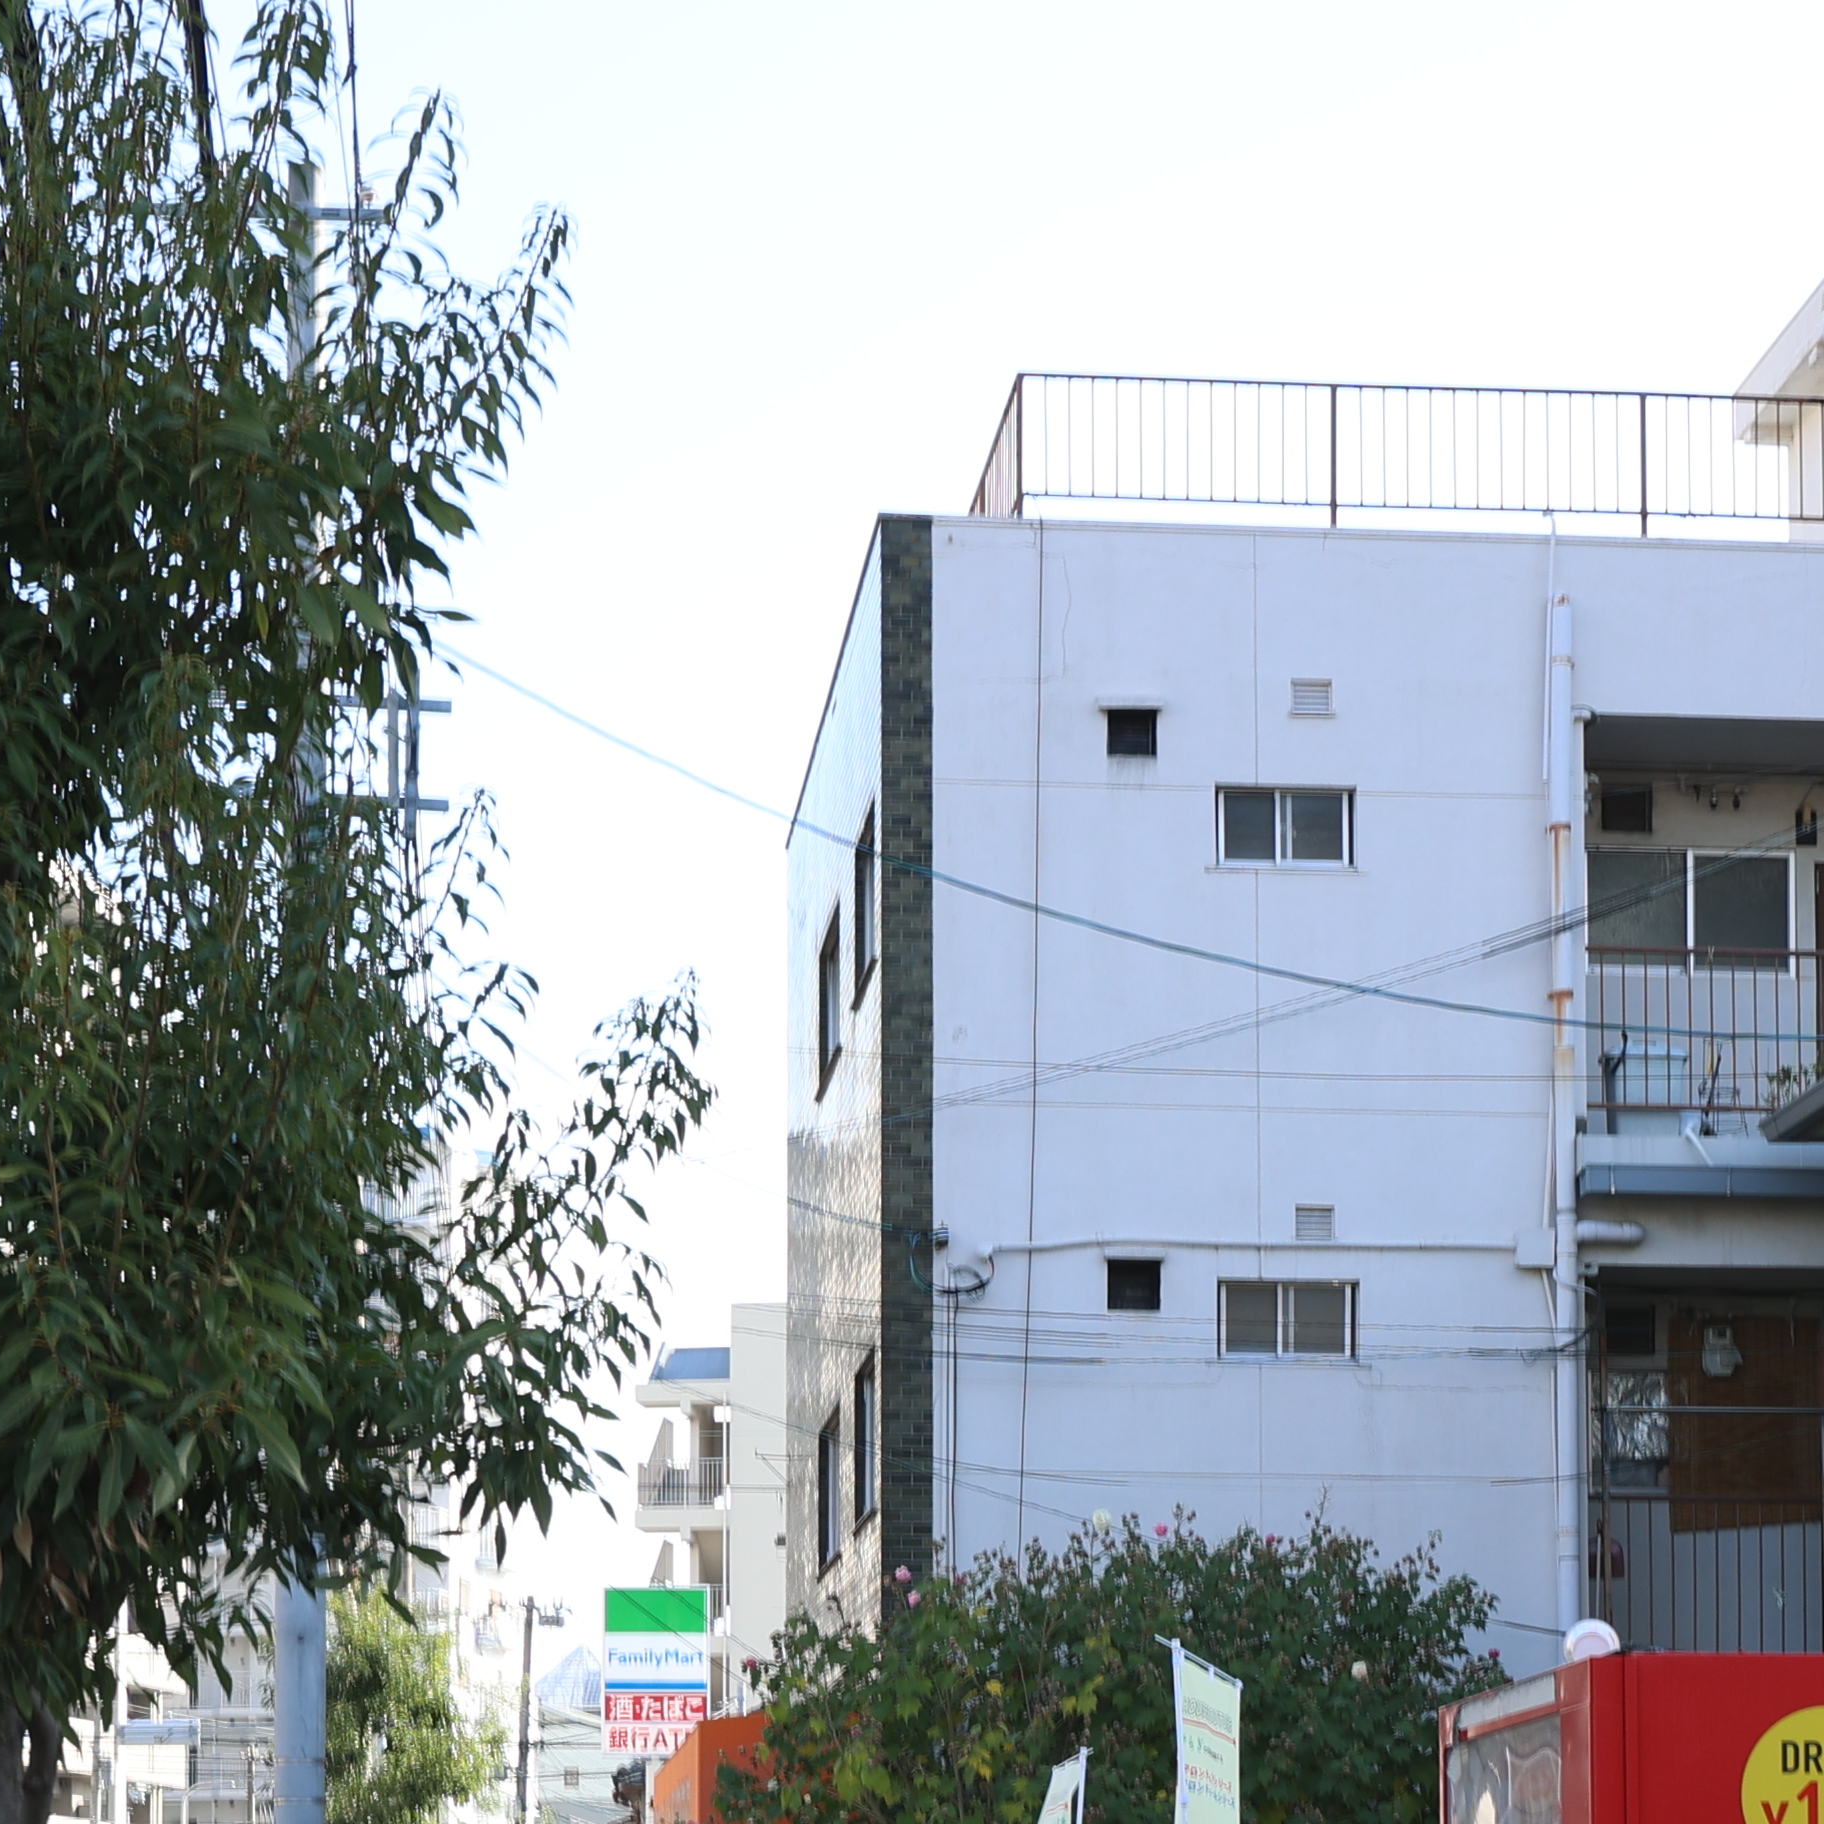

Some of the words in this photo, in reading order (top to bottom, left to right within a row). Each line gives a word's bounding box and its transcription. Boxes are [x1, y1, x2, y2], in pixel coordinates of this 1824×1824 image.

[608, 1648, 703, 1668] FamilyMart
[609, 1695, 704, 1721] 酒・たばこ
[609, 1727, 693, 1752] 銀行AT
